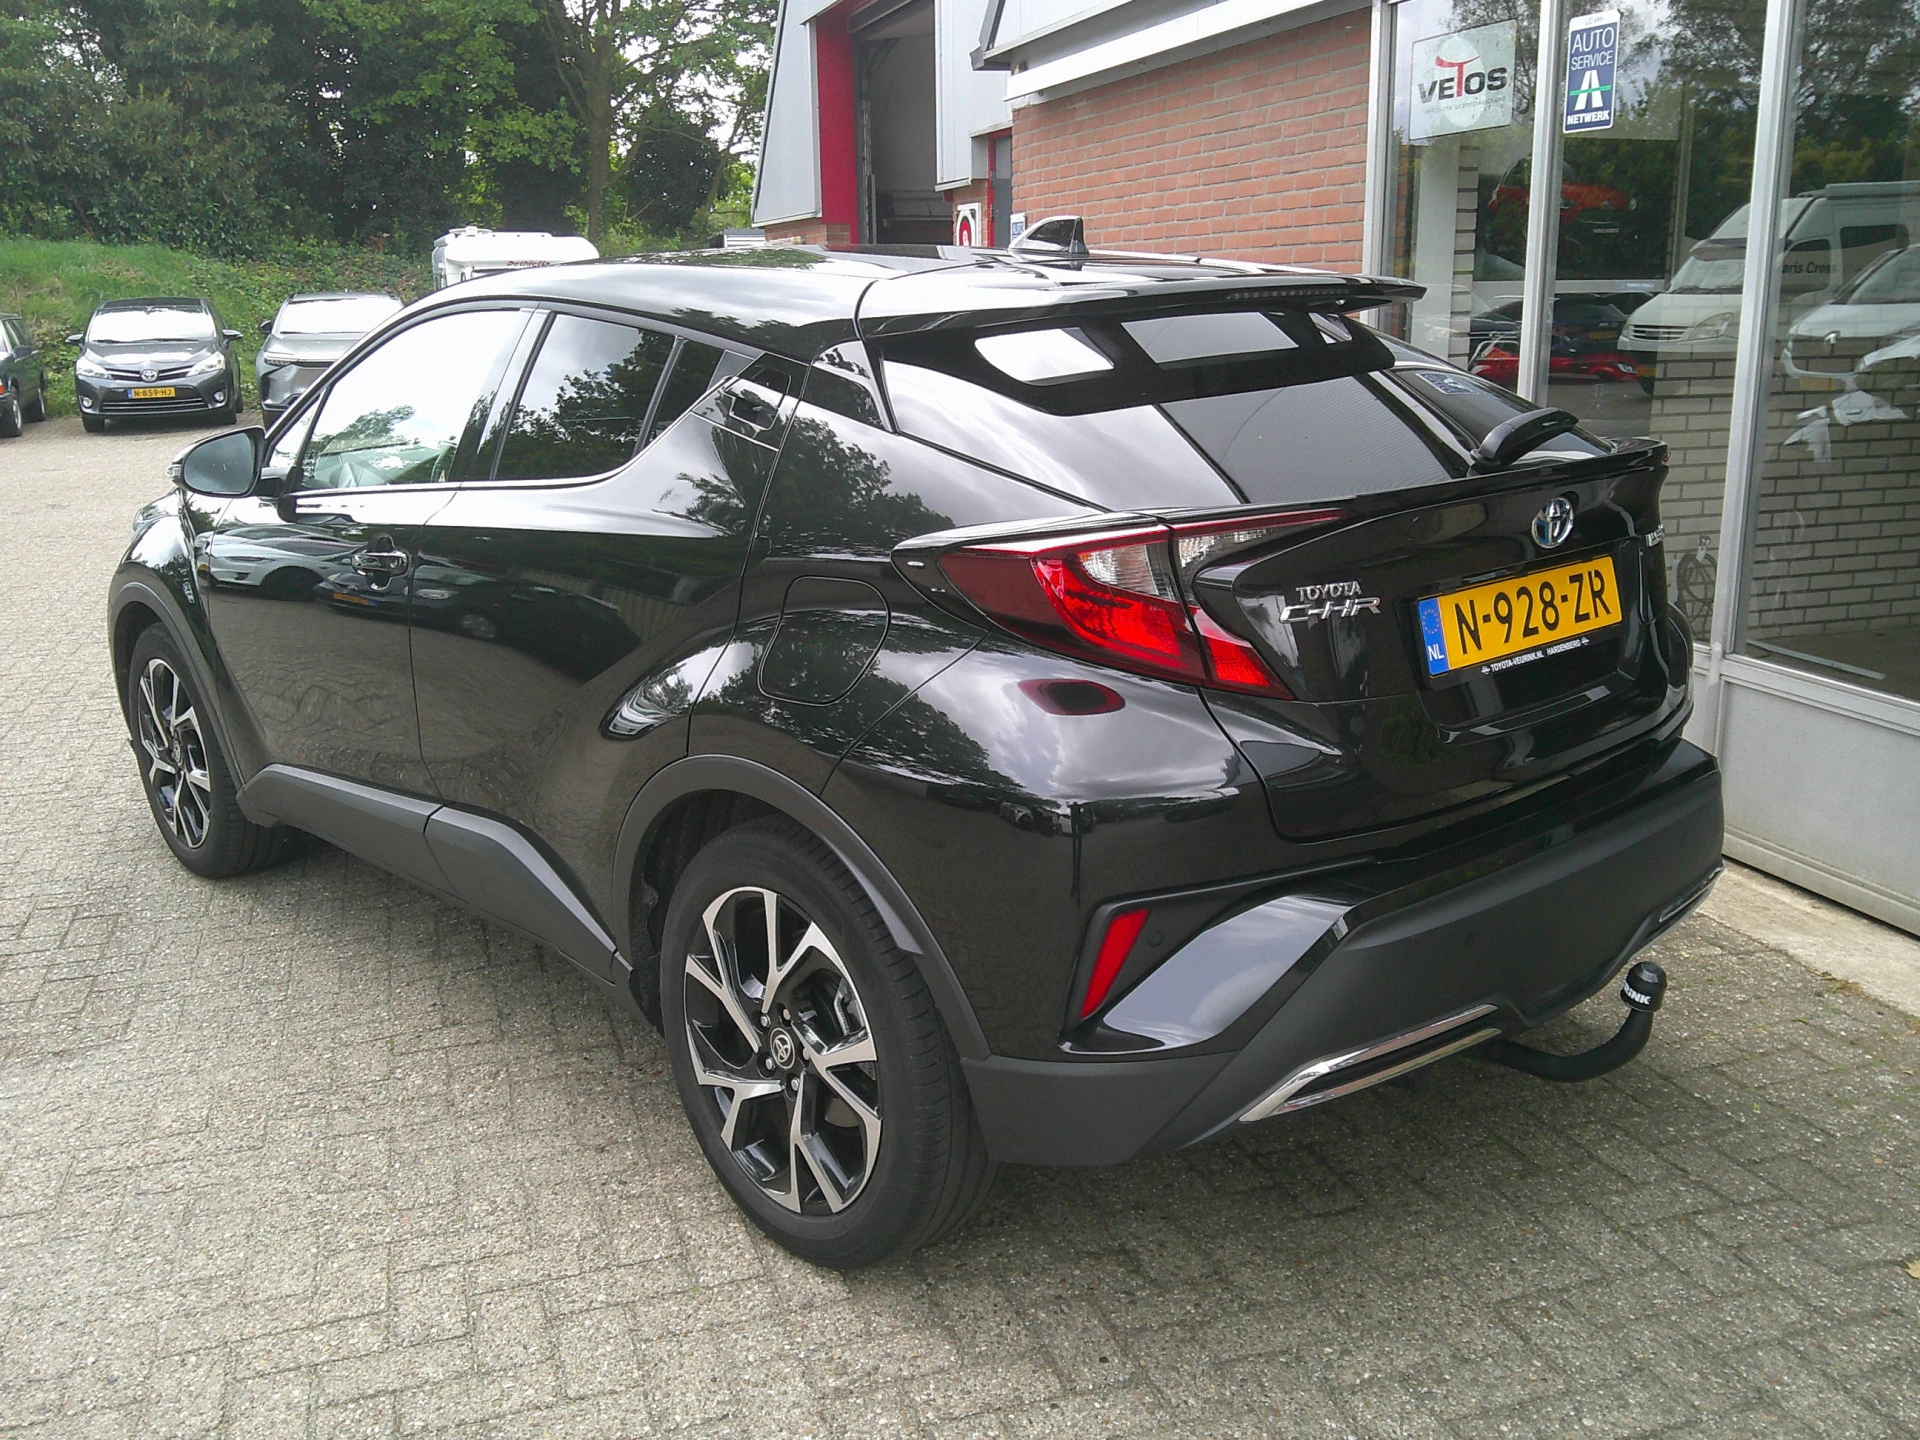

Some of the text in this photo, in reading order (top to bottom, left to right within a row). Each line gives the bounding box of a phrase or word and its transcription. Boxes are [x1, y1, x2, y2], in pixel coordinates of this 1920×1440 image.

[1571, 27, 1615, 54] AUTO
[1571, 50, 1614, 71] SERVICE
[1418, 55, 1507, 104] VETOS
[1567, 110, 1610, 125] NETWERK
[1295, 581, 1362, 601] TOYOTA
[1280, 597, 1381, 623] C-HR
[1454, 569, 1611, 655] N-928-ZR
[1427, 644, 1445, 662] NL
[1490, 639, 1581, 672] TOYOTA-VEURINK.NL HARDENBERG
